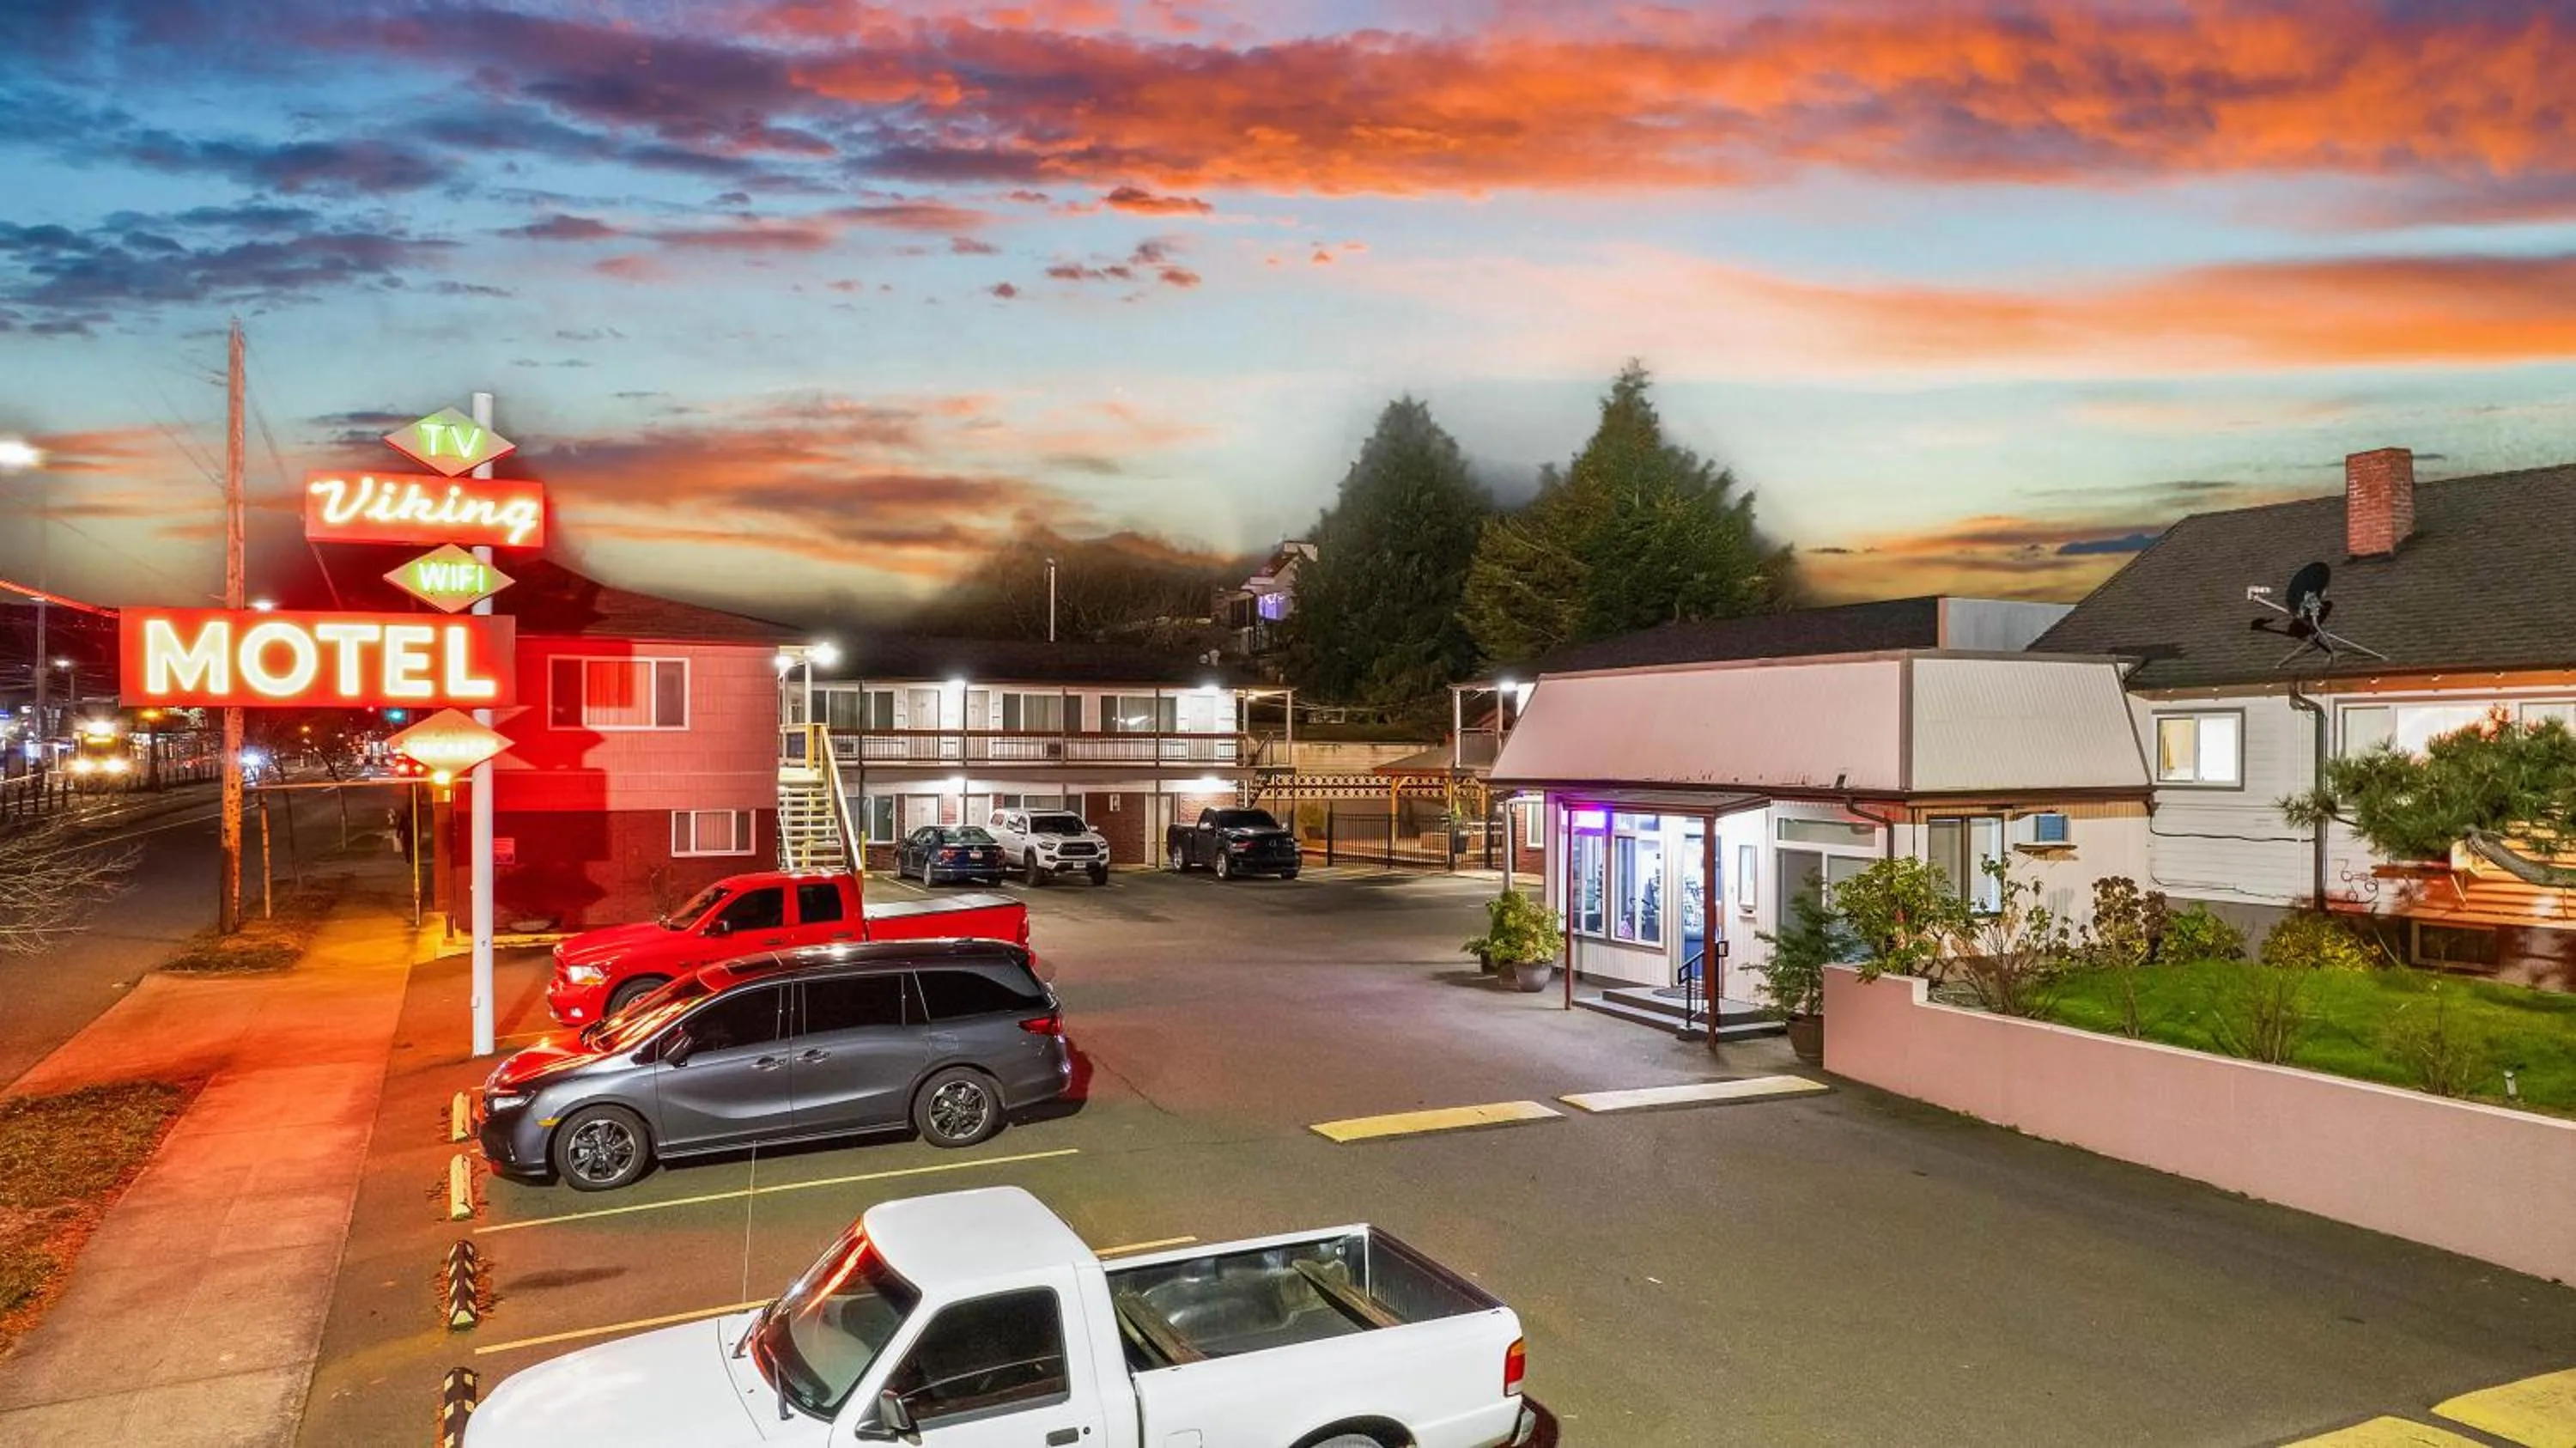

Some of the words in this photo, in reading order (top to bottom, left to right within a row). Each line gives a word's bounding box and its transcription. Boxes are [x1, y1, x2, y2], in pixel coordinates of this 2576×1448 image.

[419, 424, 481, 458] TV
[309, 477, 538, 545] Viking
[418, 563, 483, 592] WIFI
[144, 619, 496, 697] MOTEL
